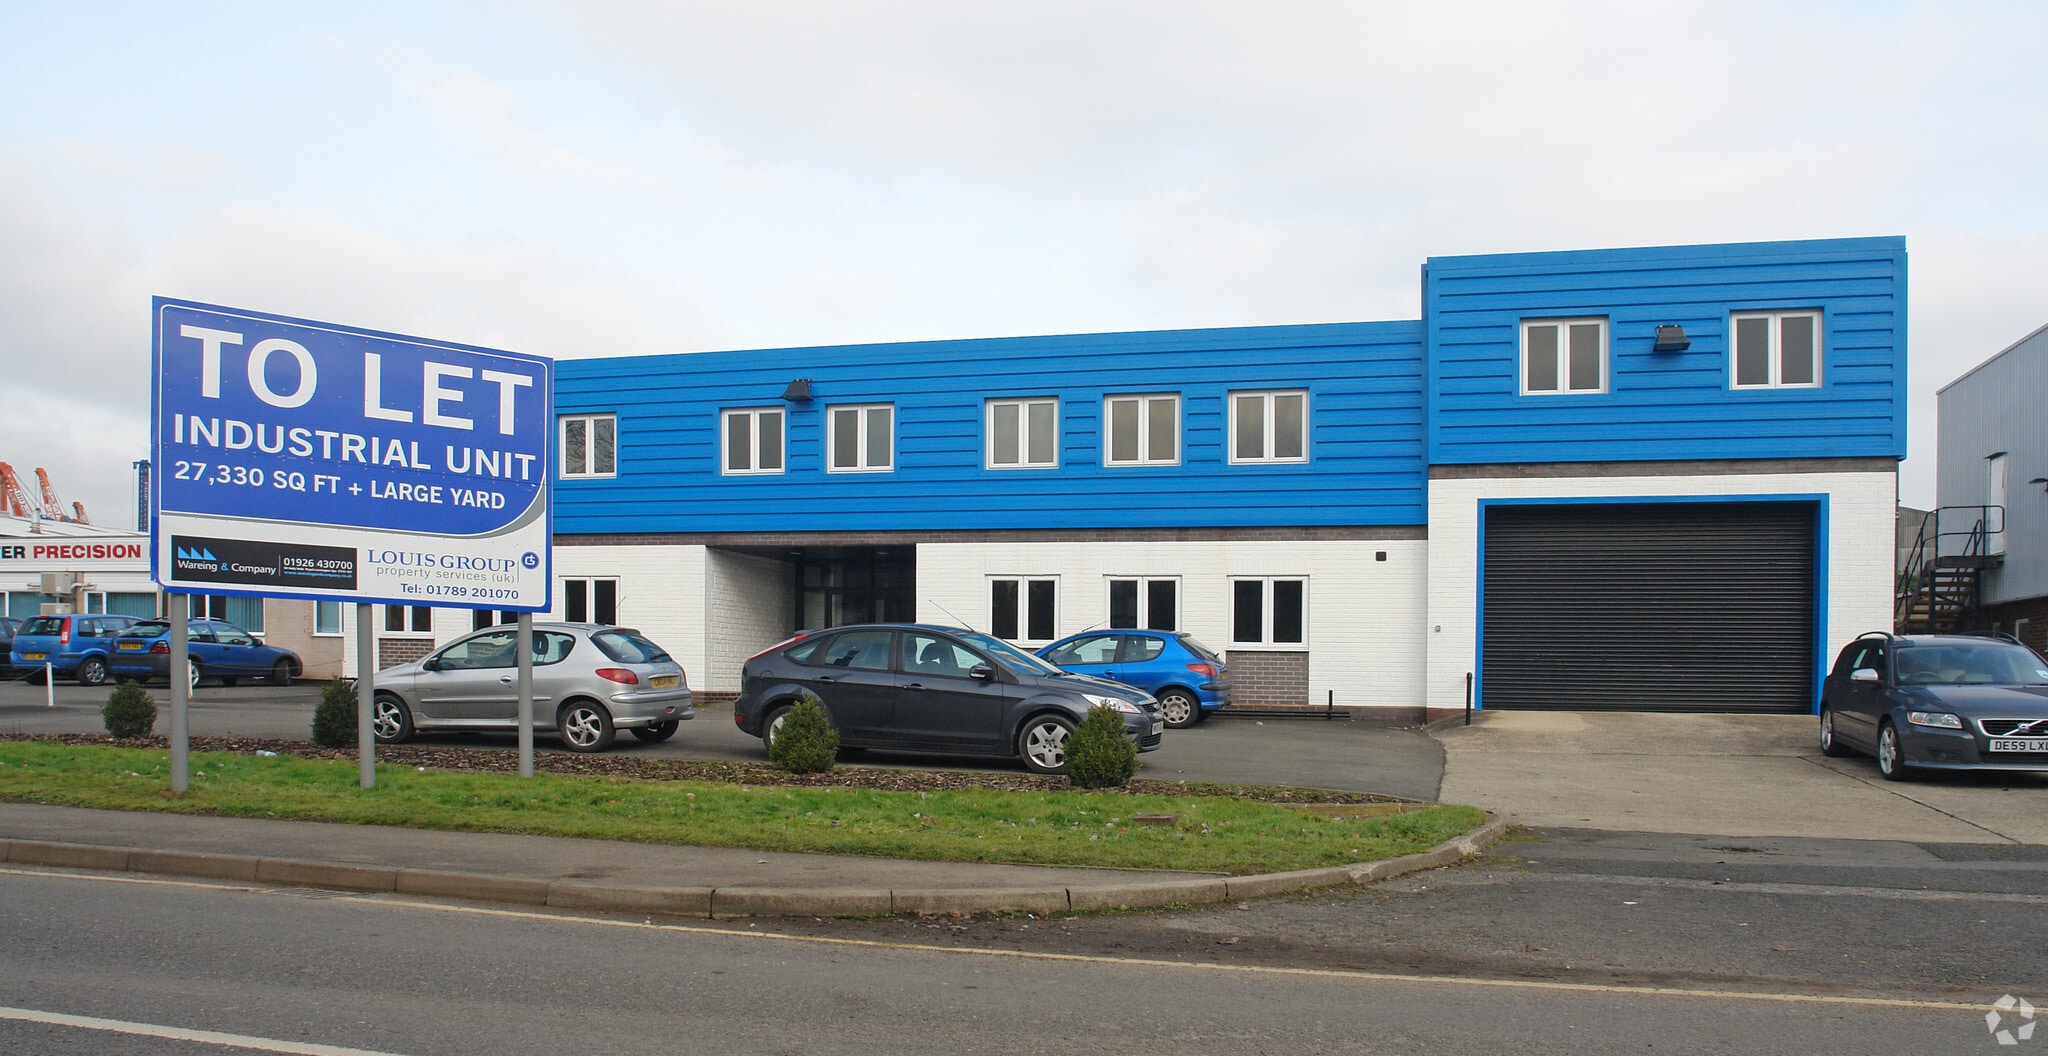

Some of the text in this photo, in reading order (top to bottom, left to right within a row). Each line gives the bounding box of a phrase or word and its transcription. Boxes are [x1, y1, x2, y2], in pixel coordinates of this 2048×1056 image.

[180, 324, 533, 435] TO LET
[174, 413, 536, 480] INDUSTRIAL UNIT
[174, 460, 506, 510] 27,330 SQ FT + LARGE YARD
[0, 544, 141, 559] ER PRECISION
[178, 560, 218, 572] Wareing
[221, 562, 229, 571] &
[231, 563, 276, 576] Company
[284, 558, 314, 568] 01926
[316, 560, 352, 570] 430700
[367, 549, 436, 567] LOUIS
[440, 555, 515, 572] GROUP
[376, 566, 515, 583] property services (uk)
[401, 583, 519, 600] Tel: 01789 201070
[1995, 741, 2048, 750] DE59 LX
